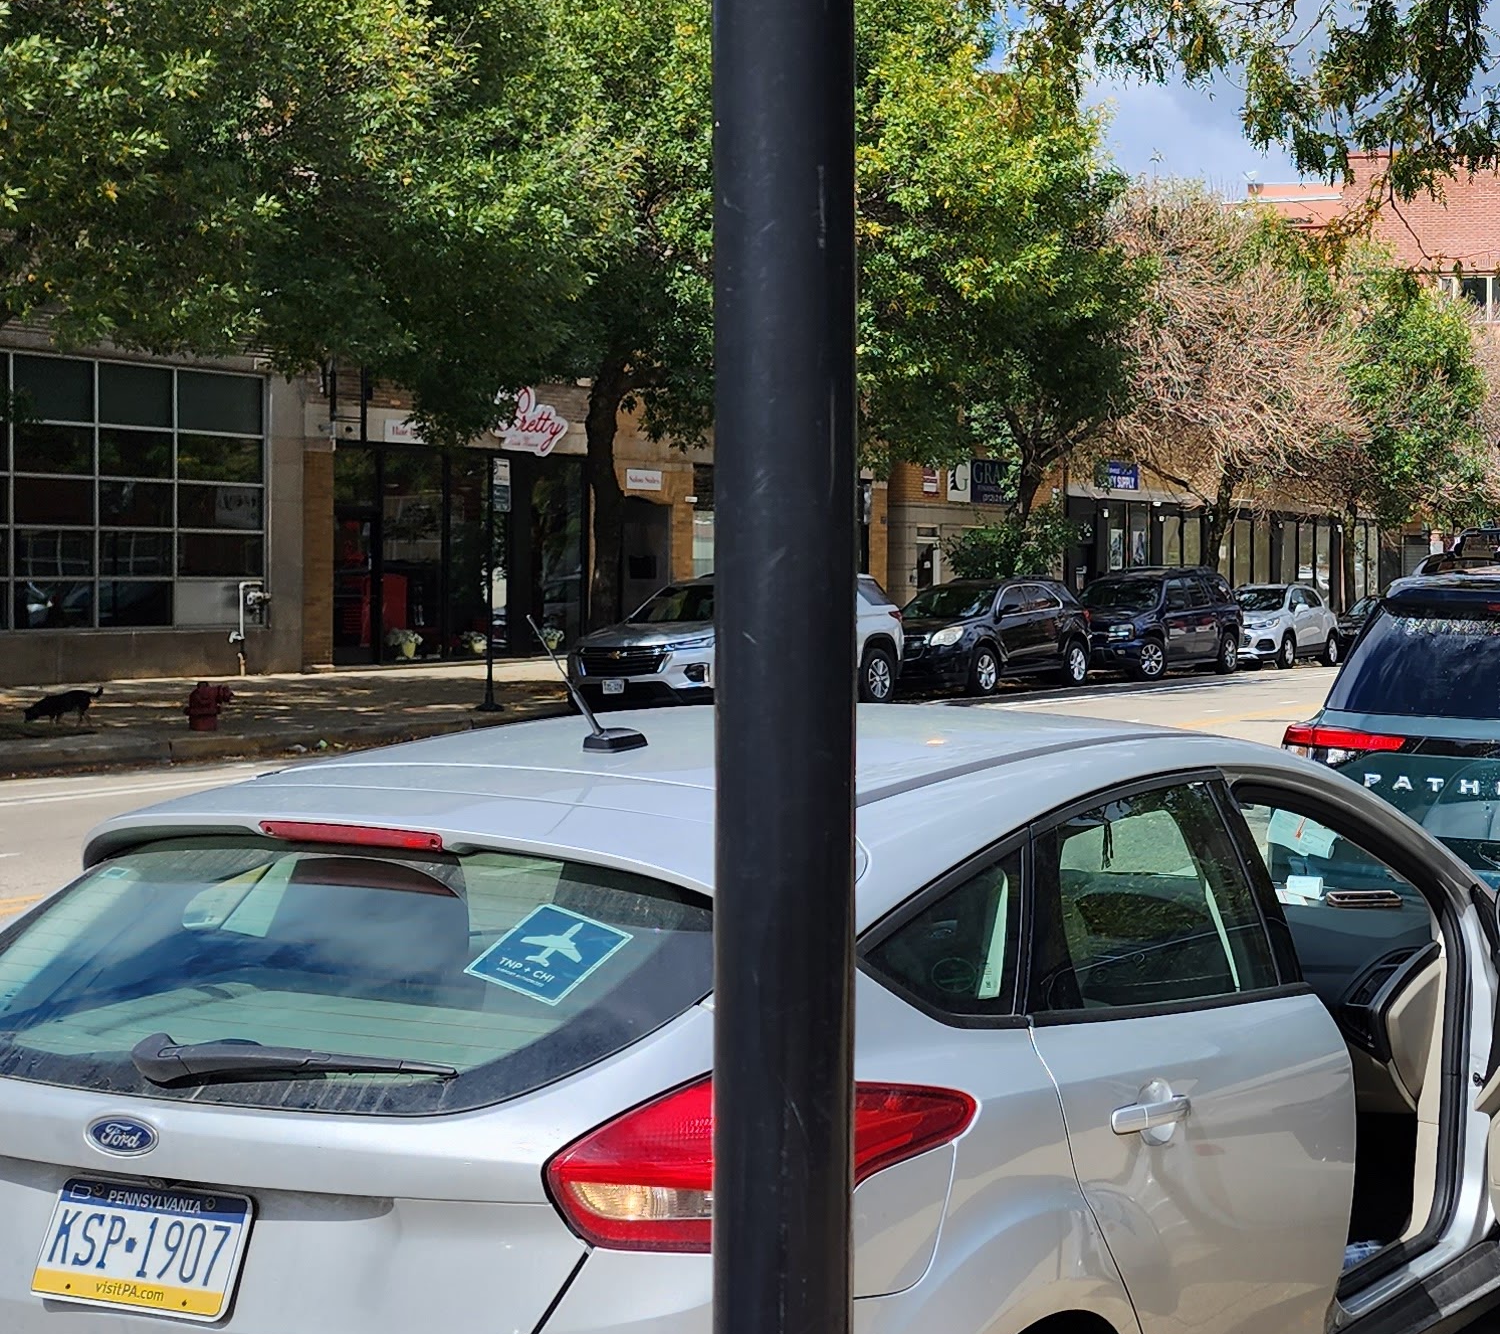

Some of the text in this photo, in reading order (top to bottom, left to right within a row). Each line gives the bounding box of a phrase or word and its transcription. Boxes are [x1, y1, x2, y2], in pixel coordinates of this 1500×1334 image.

[499, 957, 523, 969] TNP
[533, 970, 555, 982] CHI
[100, 1123, 141, 1149] Ford
[107, 1190, 201, 1215] PENNSYLVANIA
[95, 1281, 164, 1302] visitPA.com
